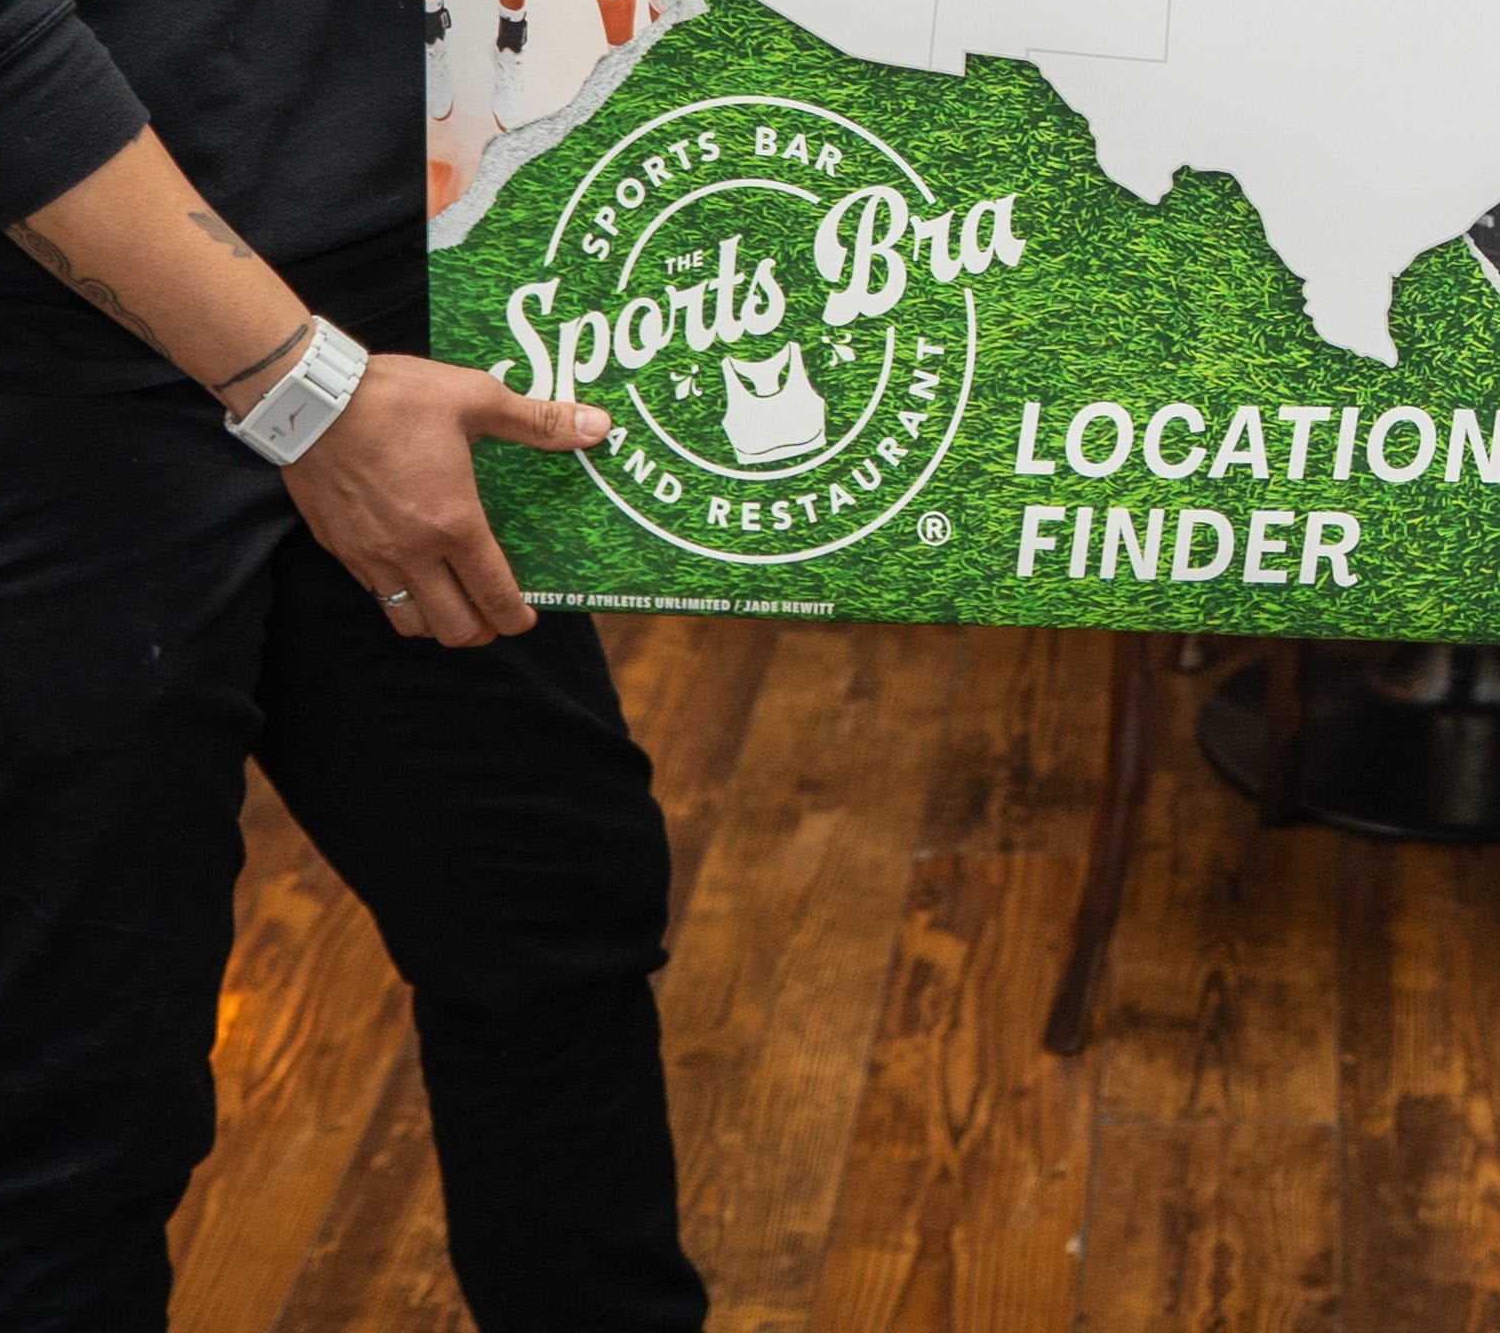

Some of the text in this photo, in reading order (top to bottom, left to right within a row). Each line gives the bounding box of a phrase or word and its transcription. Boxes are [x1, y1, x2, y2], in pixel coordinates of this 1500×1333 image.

[582, 126, 843, 262] SPORTS BAR
[489, 184, 1028, 403] Sports Bra
[664, 248, 704, 275] THE
[607, 336, 946, 532] AND RESTAURANT
[1016, 505, 1361, 588] FINDER
[566, 593, 584, 607] OF
[586, 594, 652, 610] ATHLETES
[654, 597, 732, 612] UNLIMITED
[743, 600, 778, 613] JADE
[782, 601, 835, 616] HEWITT
